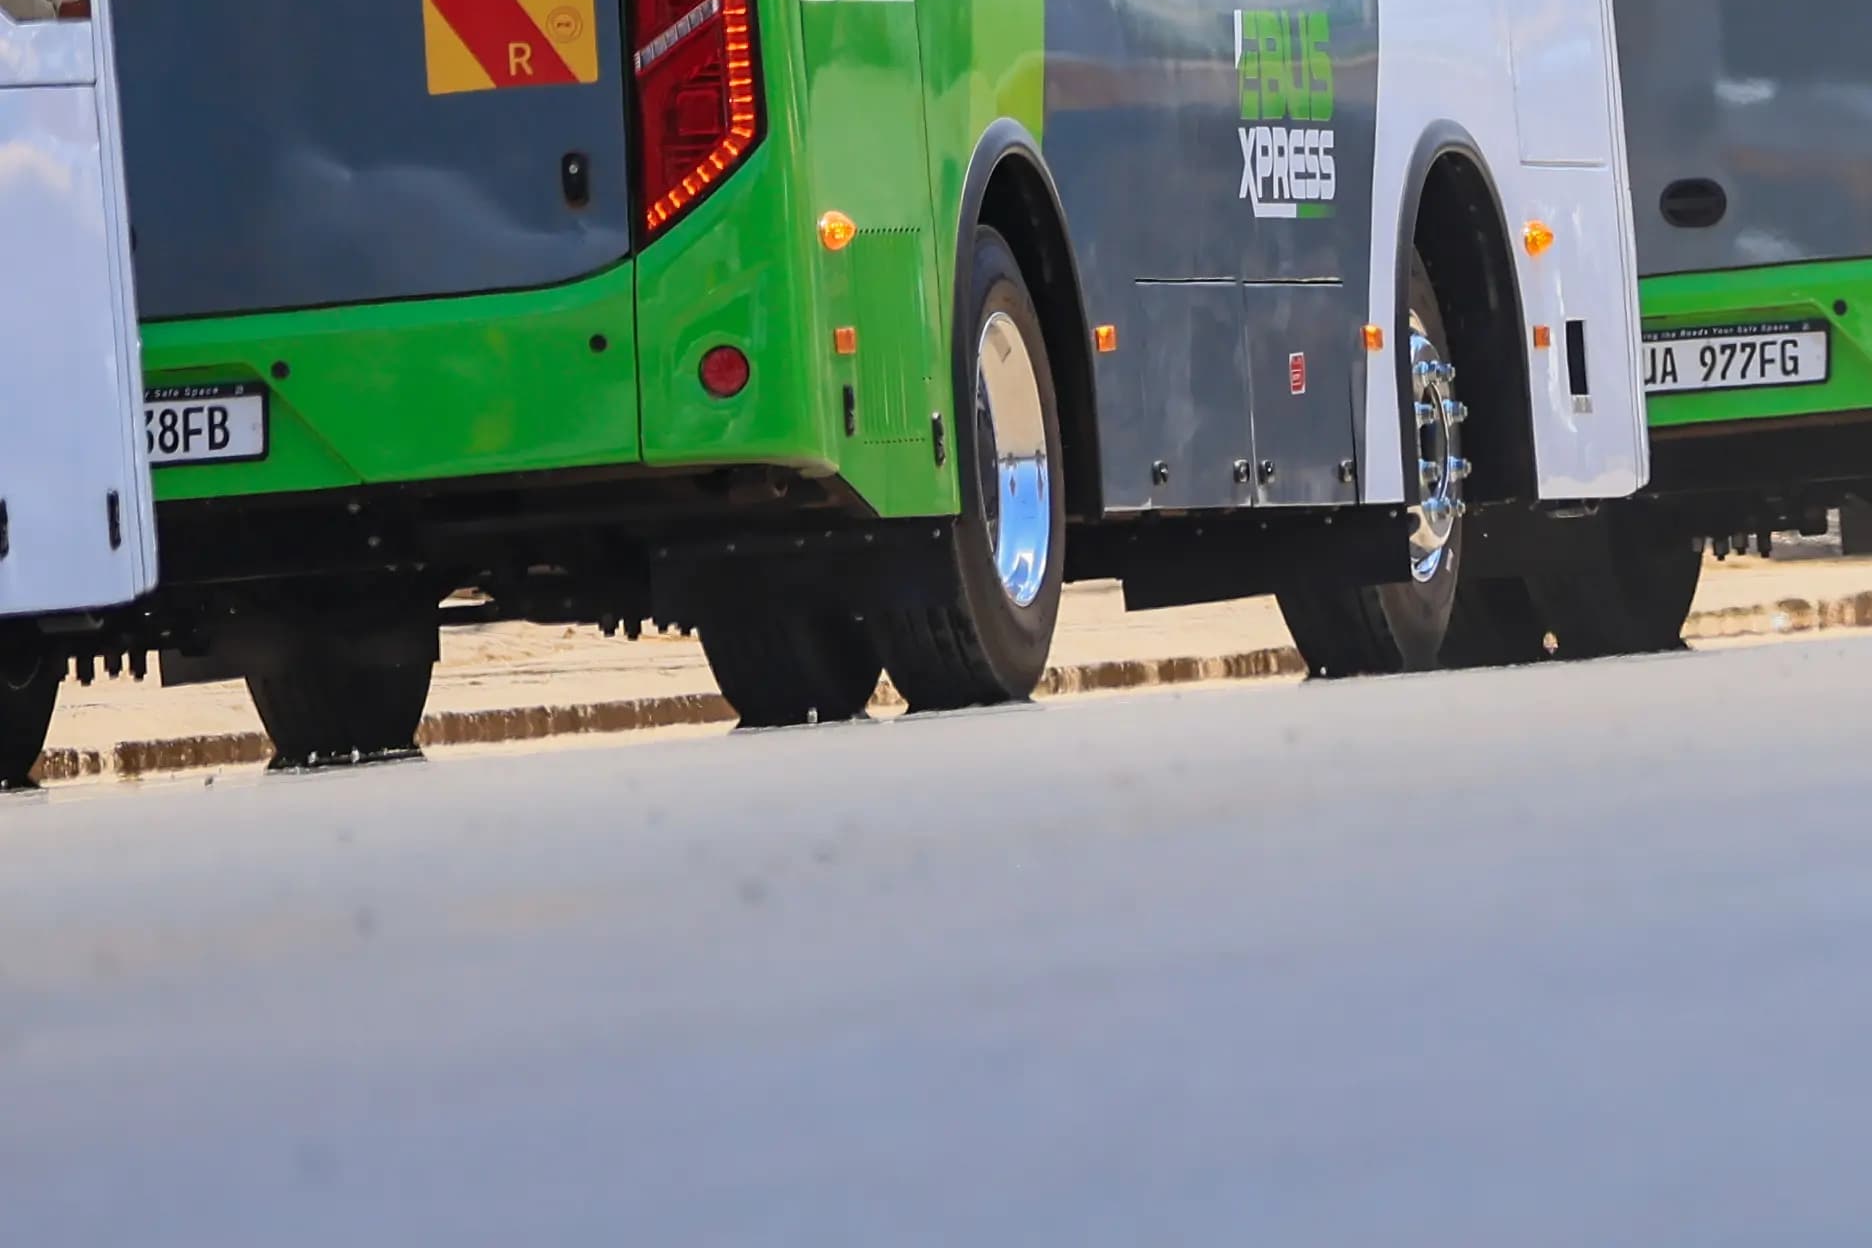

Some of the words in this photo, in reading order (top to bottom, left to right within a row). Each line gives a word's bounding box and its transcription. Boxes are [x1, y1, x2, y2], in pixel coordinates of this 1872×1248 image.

[507, 42, 532, 77] R
[1233, 8, 1335, 122] EBUS
[1237, 126, 1337, 218] XPRESS
[1700, 338, 1800, 383] 977FG
